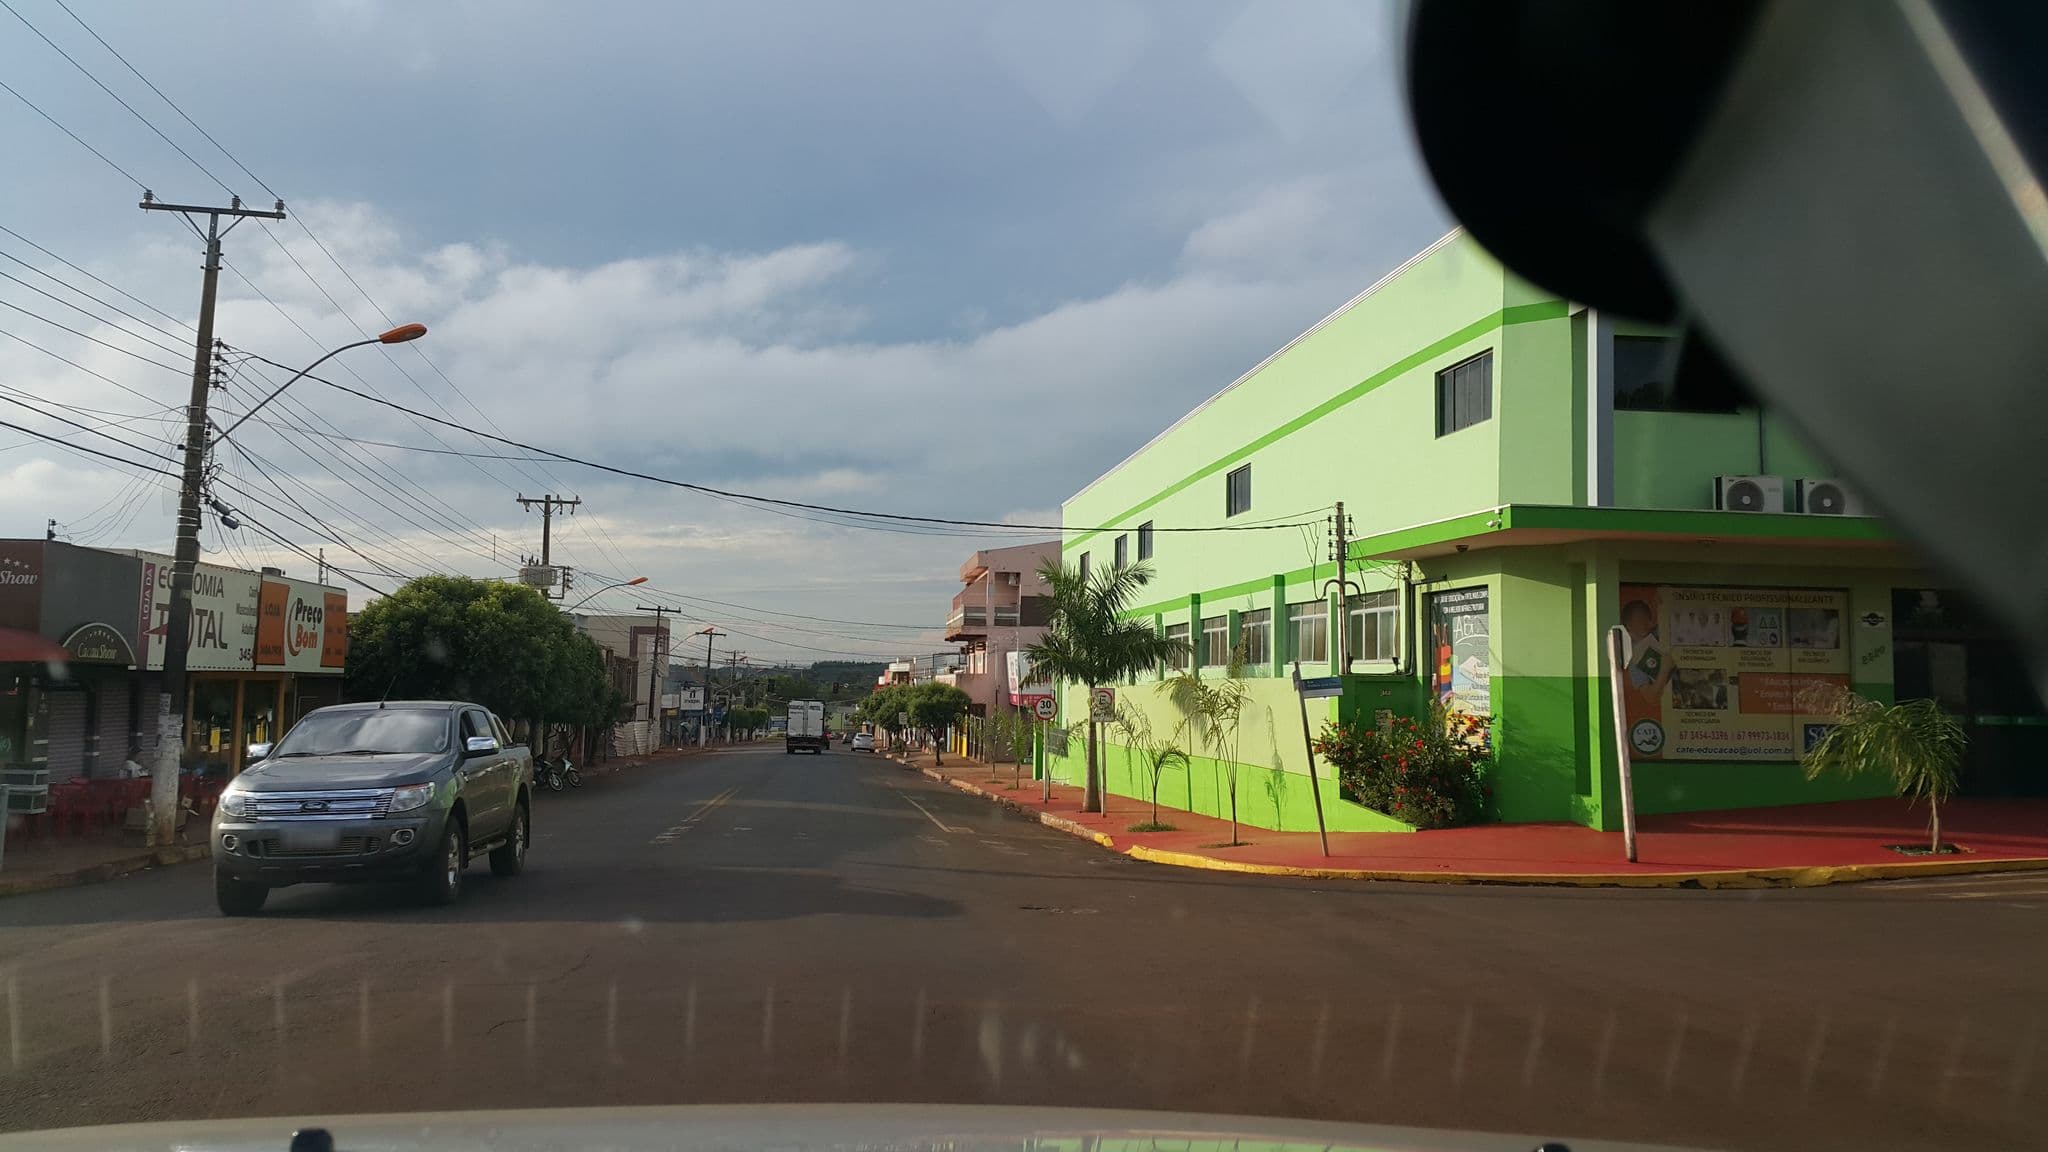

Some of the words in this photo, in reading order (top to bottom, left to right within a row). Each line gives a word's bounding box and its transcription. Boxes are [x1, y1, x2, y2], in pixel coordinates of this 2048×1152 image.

[0, 571, 38, 585] Show
[146, 568, 154, 586] DA
[159, 566, 224, 598] ECOMIA
[143, 590, 153, 620] LOJA
[295, 597, 322, 630] Preço
[156, 603, 228, 650] TTAL
[296, 624, 318, 649] Bom
[1040, 700, 1052, 709] 30
